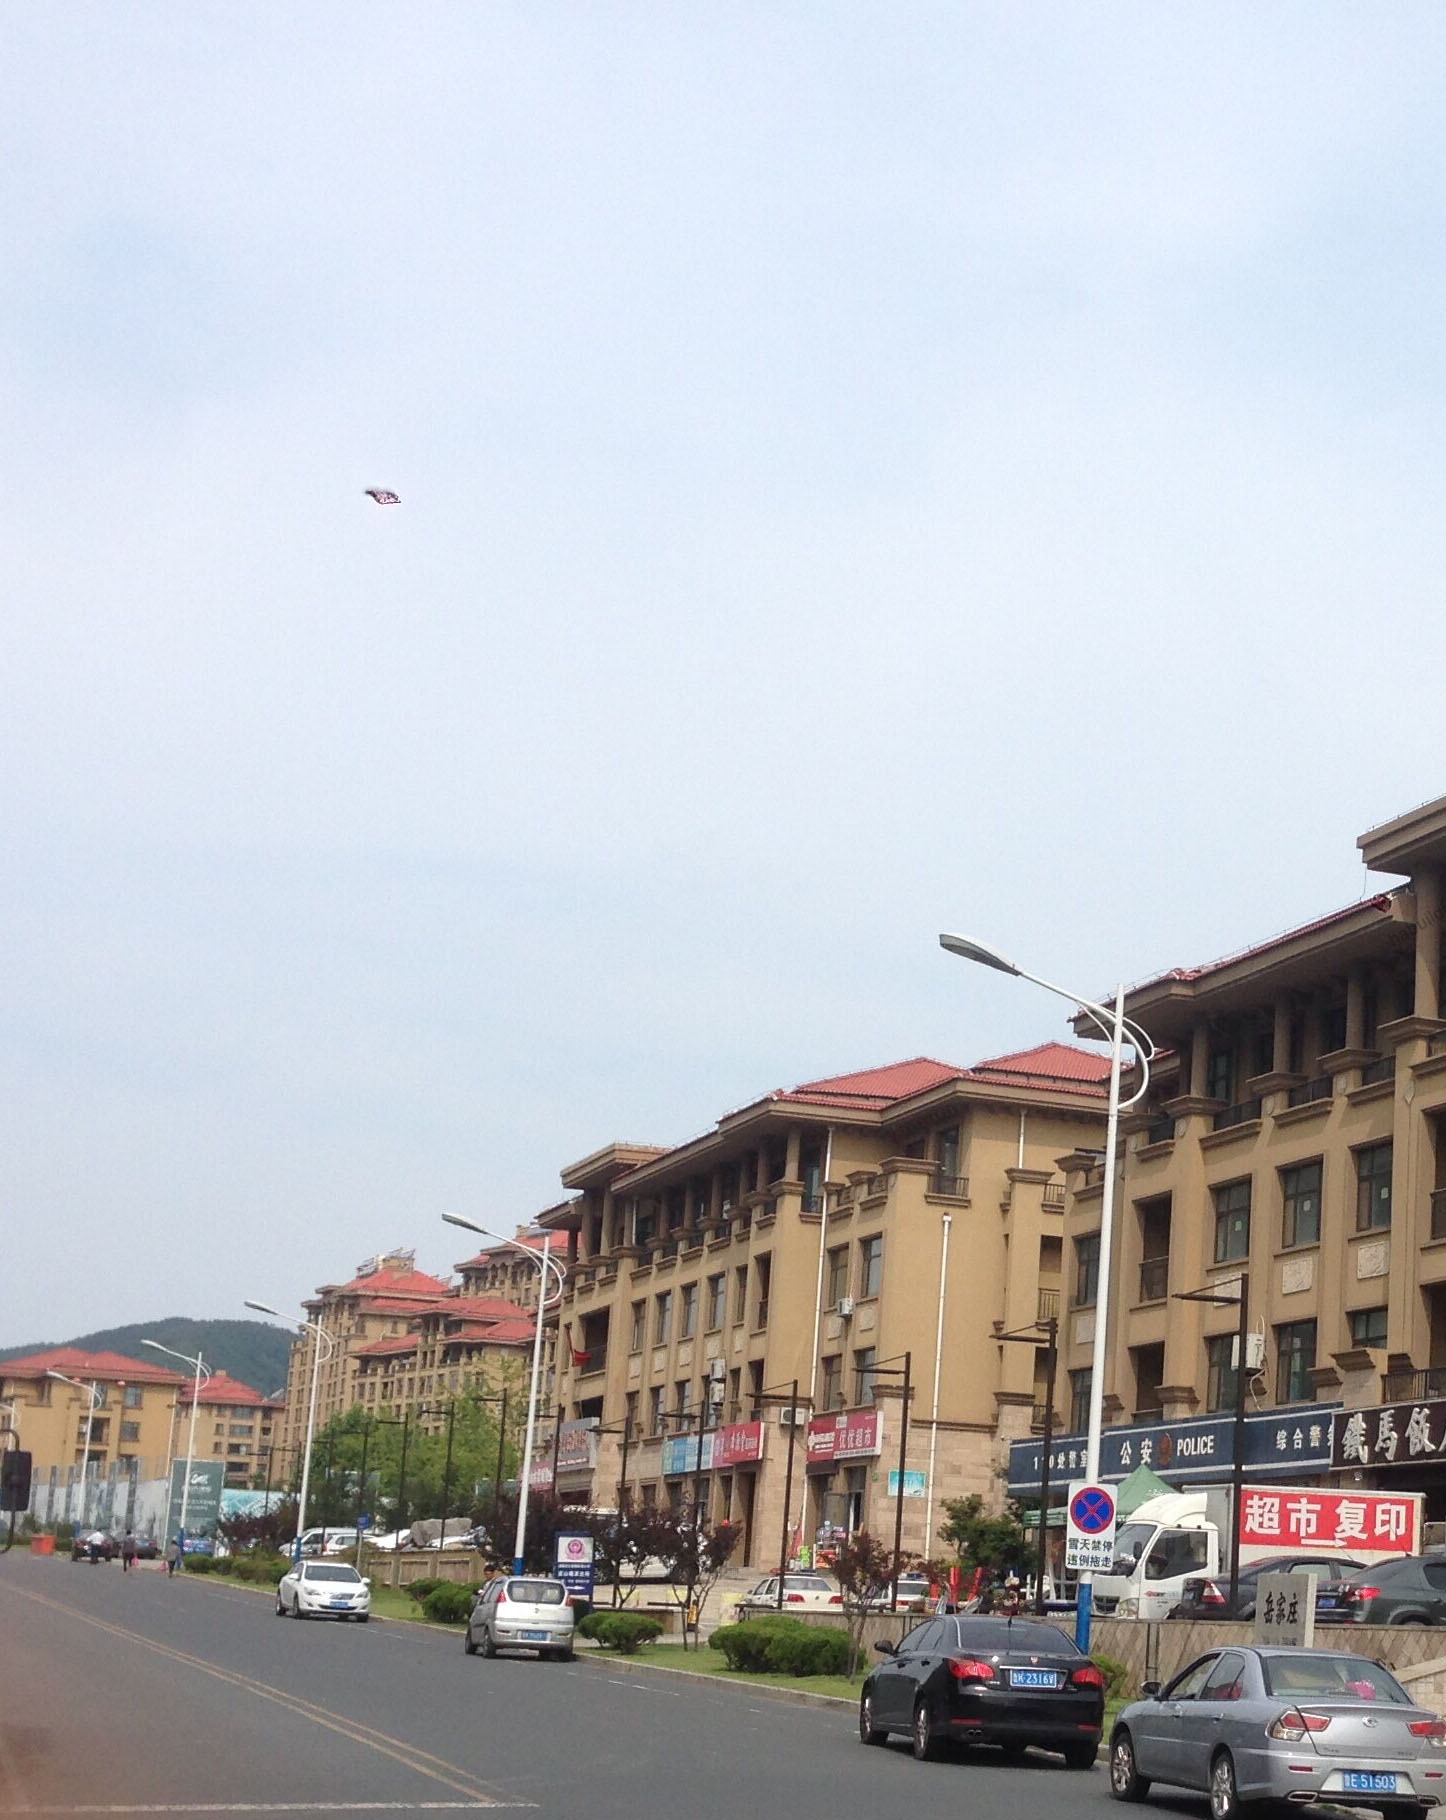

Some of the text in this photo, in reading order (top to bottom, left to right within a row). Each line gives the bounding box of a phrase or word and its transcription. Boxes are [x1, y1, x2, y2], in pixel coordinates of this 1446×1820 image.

[1033, 1449, 1089, 1471] 10处警室
[1120, 1435, 1214, 1466] 公安 POLICE
[1245, 1495, 1408, 1542] 超市复印
